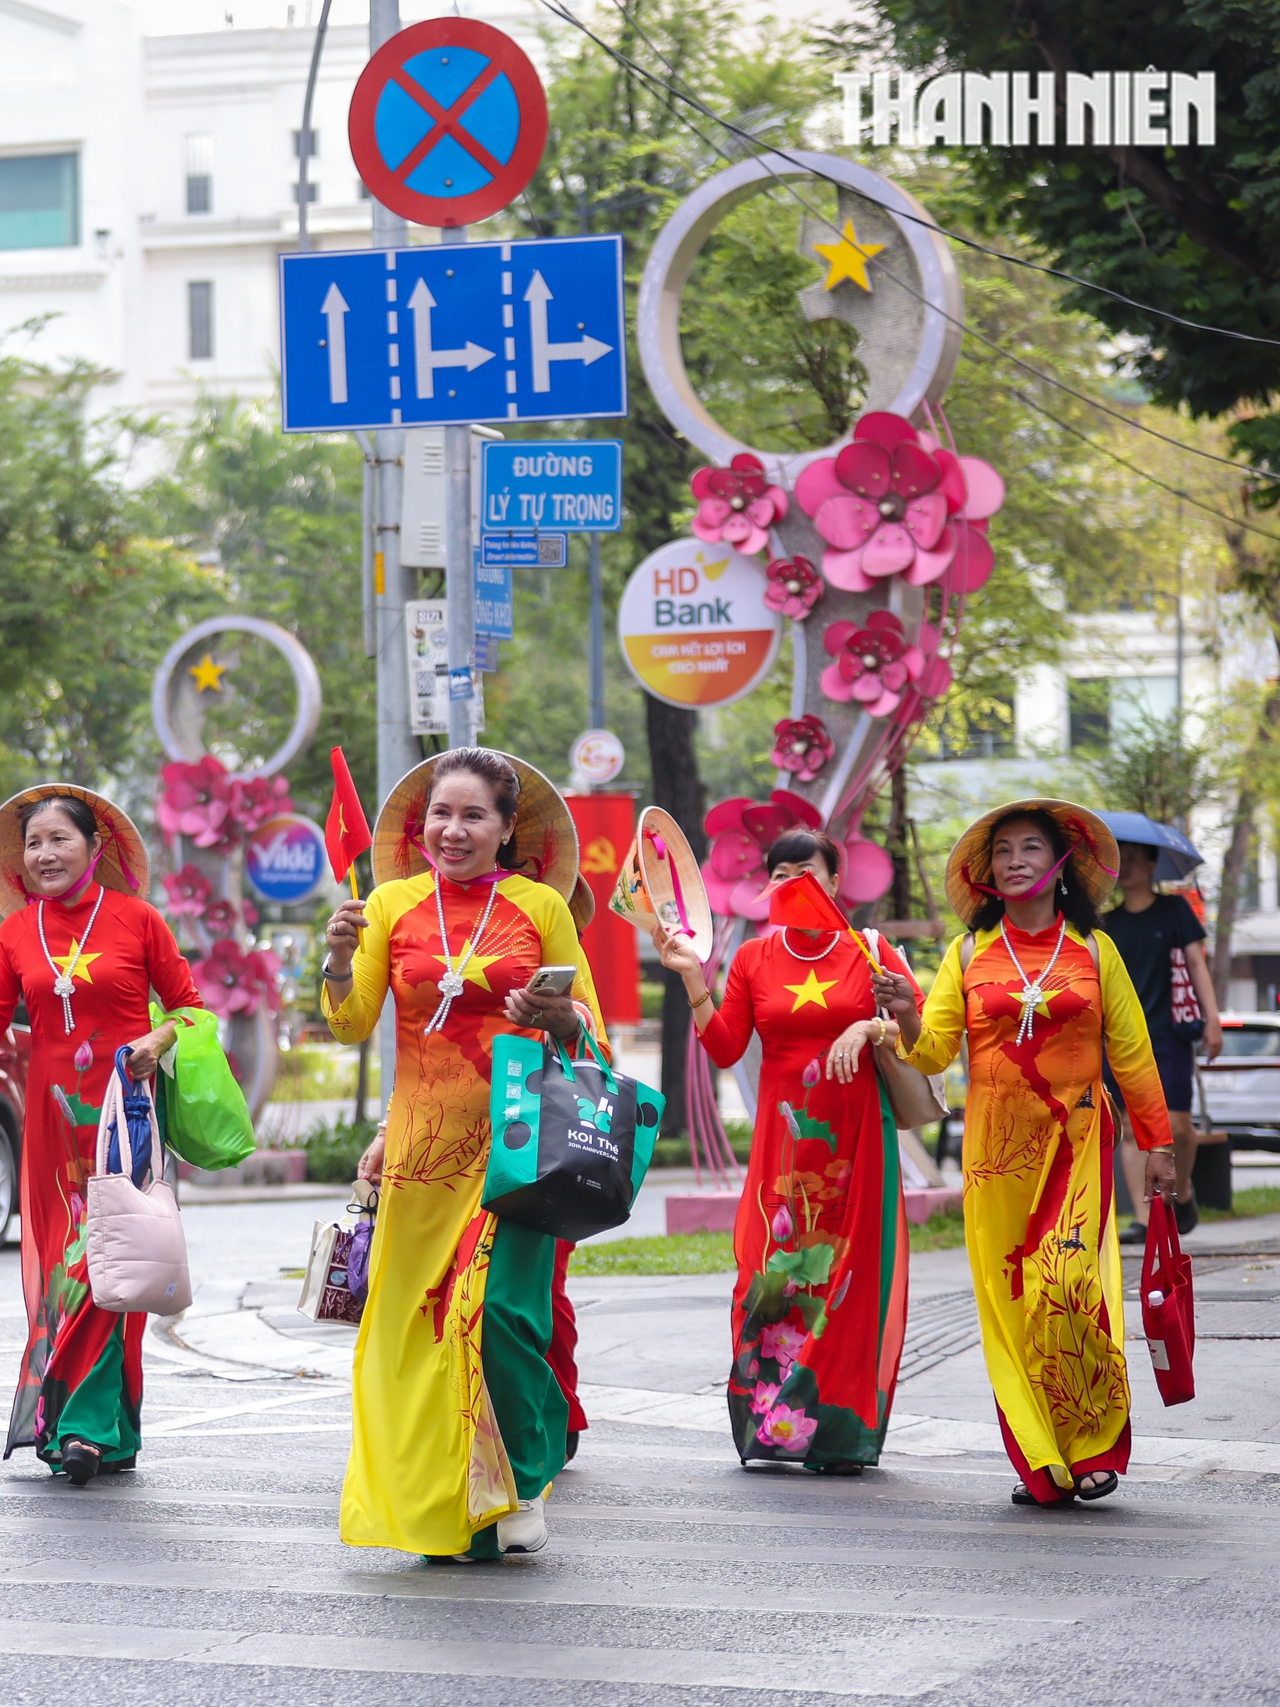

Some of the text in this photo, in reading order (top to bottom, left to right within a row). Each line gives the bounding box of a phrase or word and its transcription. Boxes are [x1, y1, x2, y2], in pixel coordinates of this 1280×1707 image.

[512, 452, 594, 477] ĐƯỜNG
[489, 486, 614, 526] LÝ TỰ TRỌNG
[654, 567, 700, 596] HD
[655, 598, 733, 627] Bank
[252, 830, 316, 871] Vikki
[568, 1129, 619, 1155] KOI Thé
[582, 1145, 619, 1162] ANNIVERSARY
